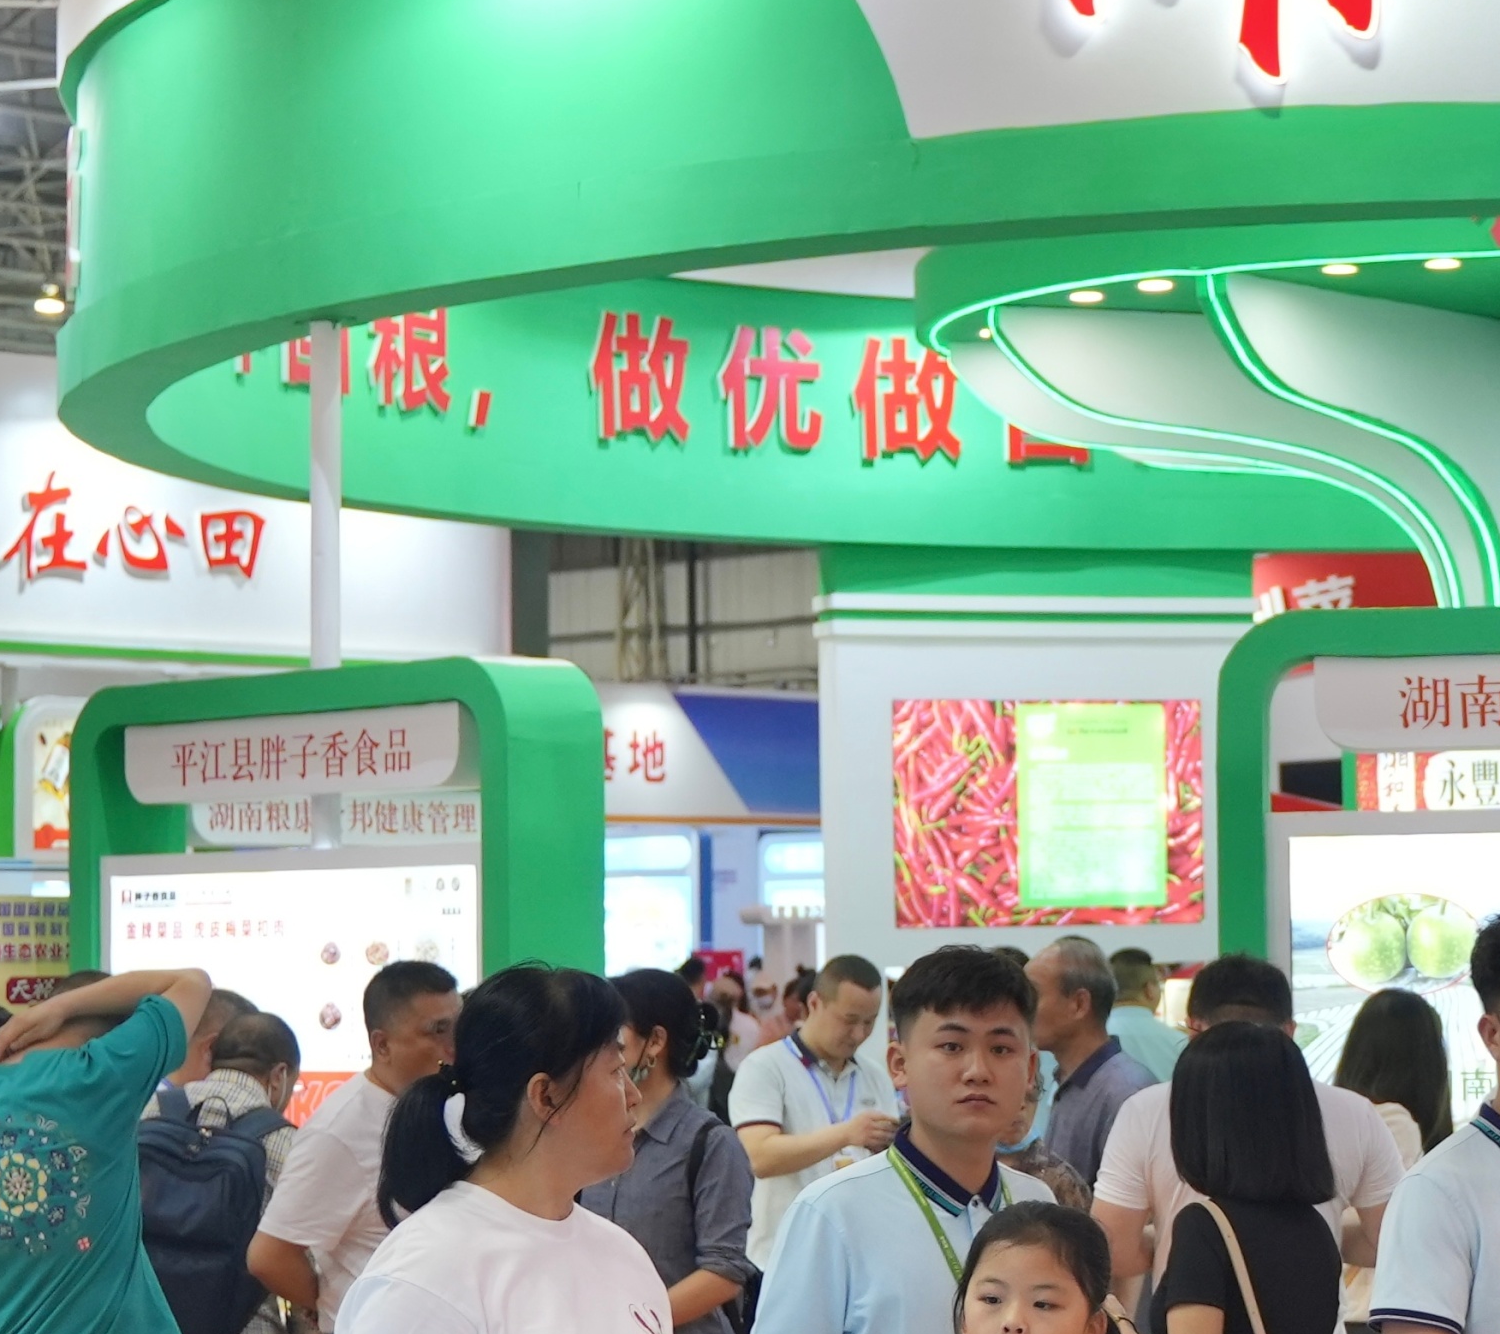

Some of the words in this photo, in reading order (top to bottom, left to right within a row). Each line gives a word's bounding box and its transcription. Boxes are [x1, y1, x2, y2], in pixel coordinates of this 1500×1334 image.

[171, 728, 412, 787] 平江县胖子香食品
[208, 798, 478, 835] 湖南粮康邦健康管理
